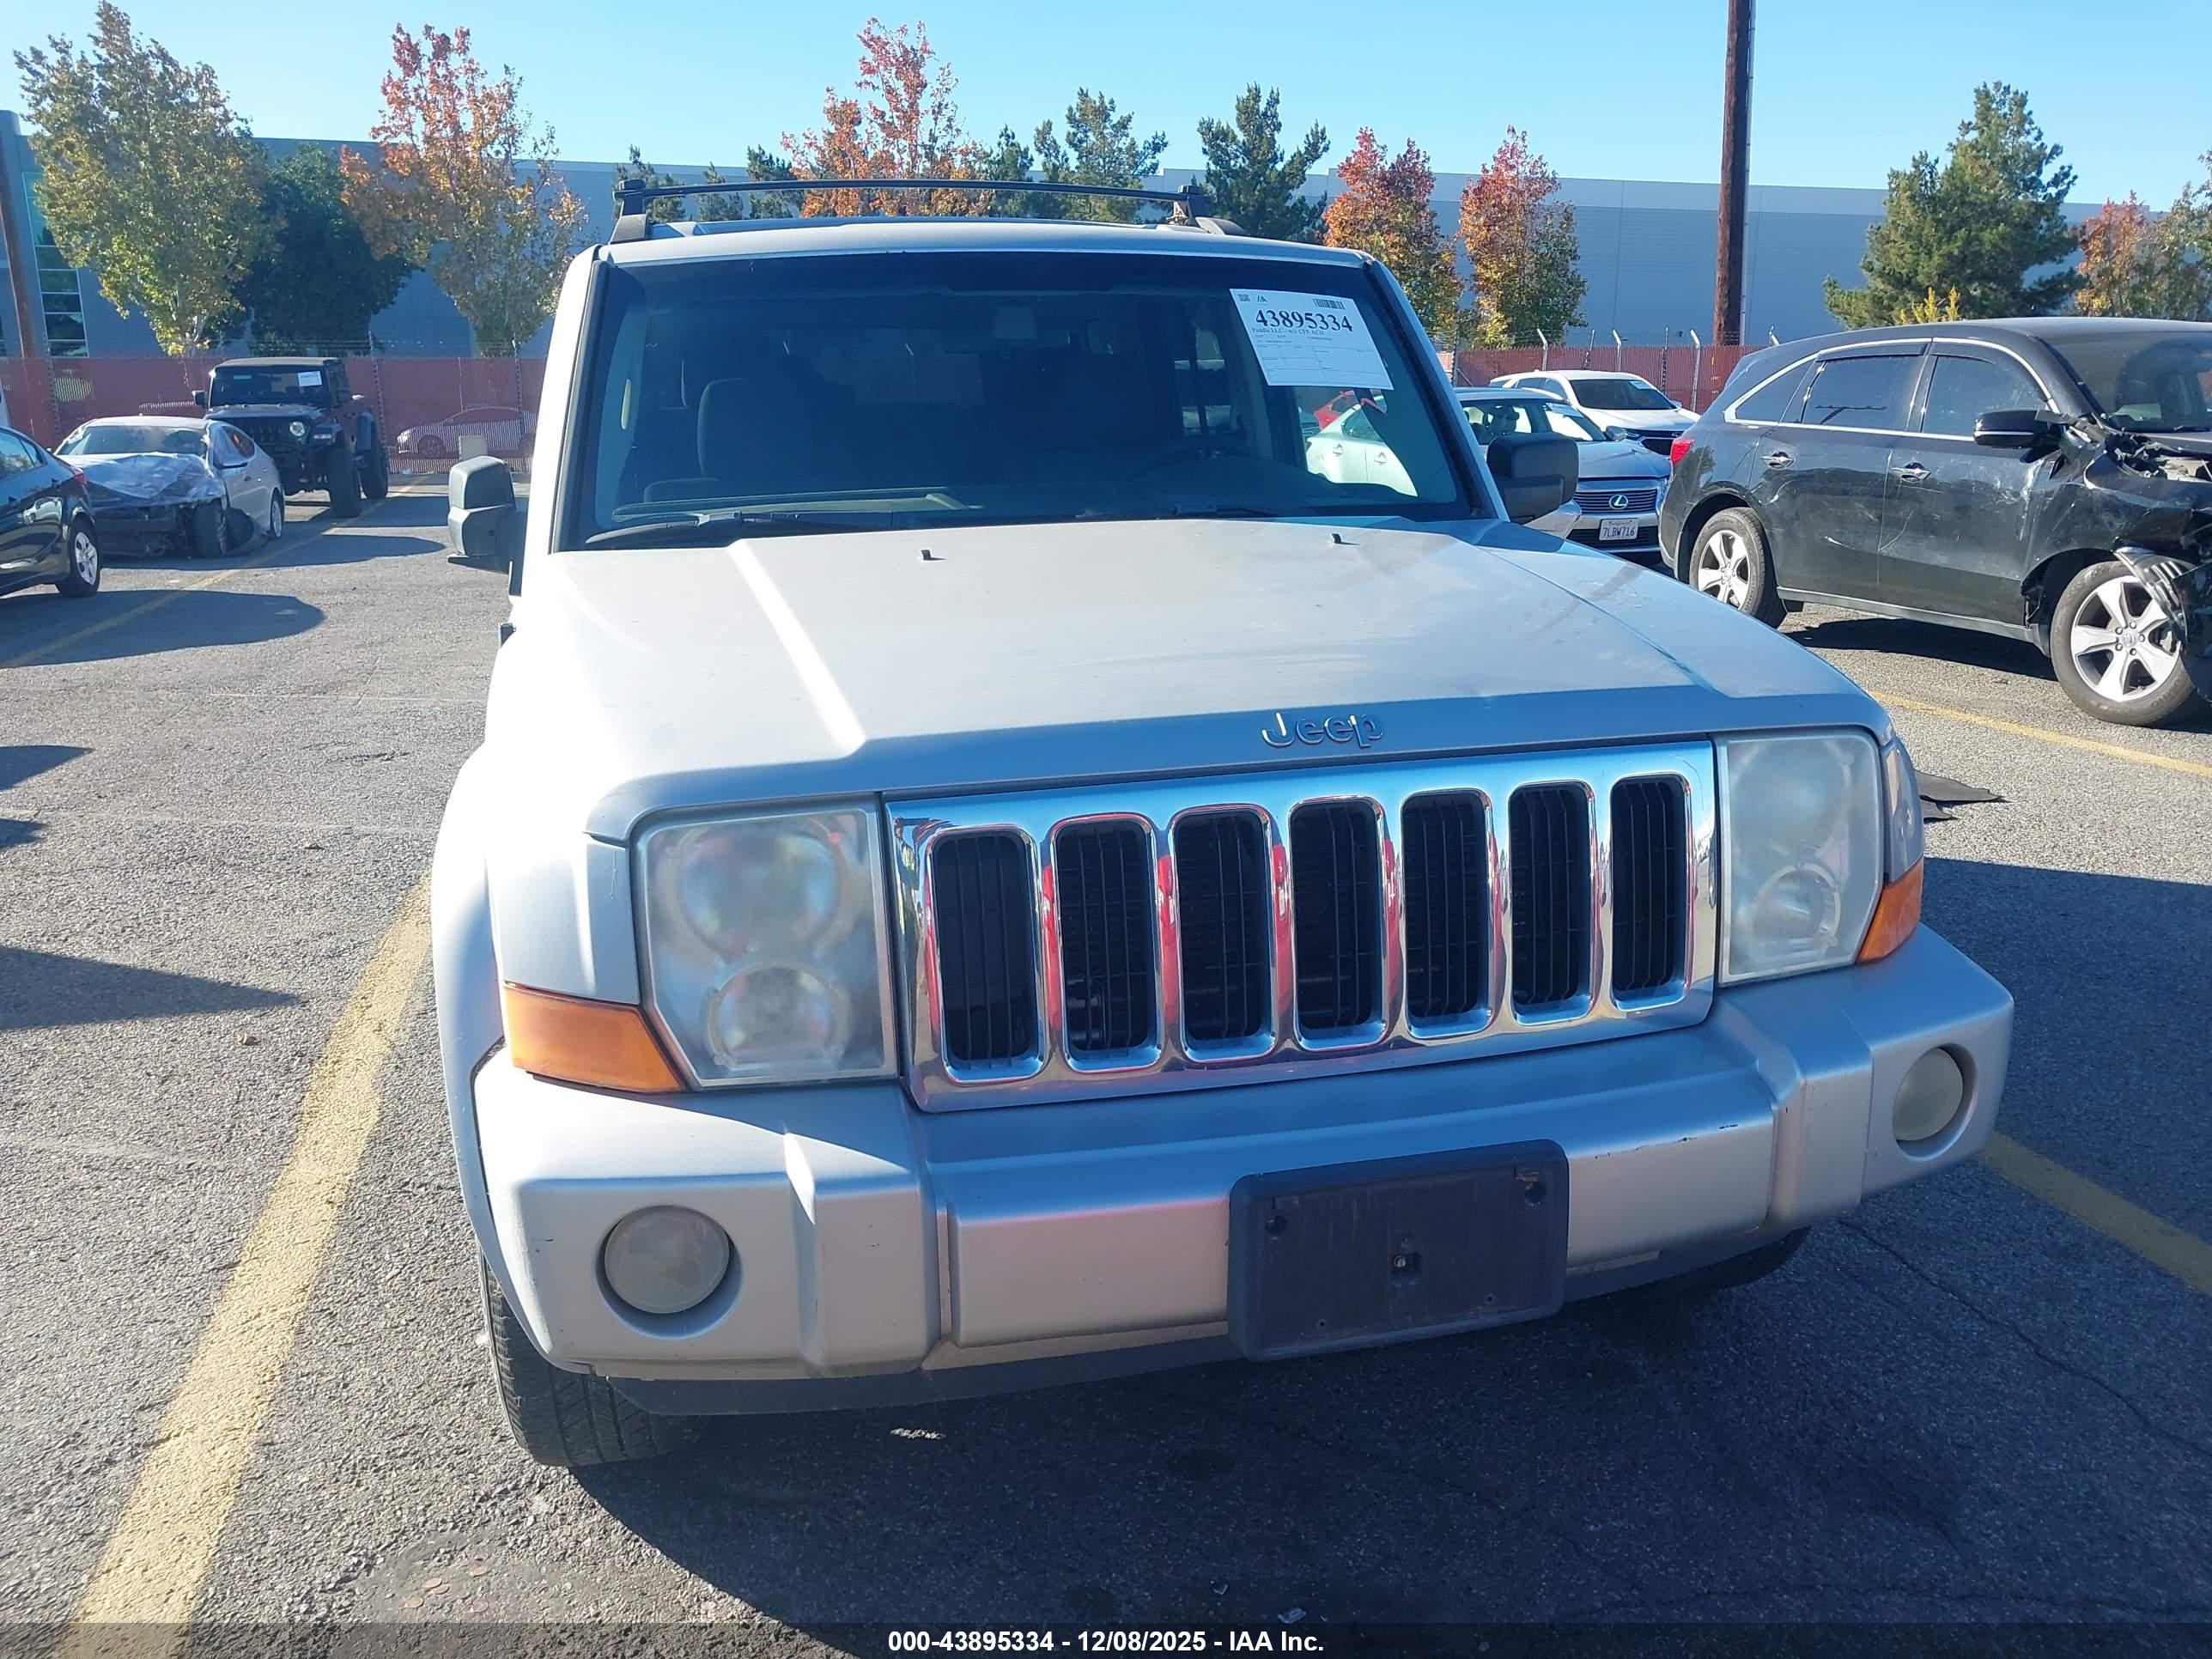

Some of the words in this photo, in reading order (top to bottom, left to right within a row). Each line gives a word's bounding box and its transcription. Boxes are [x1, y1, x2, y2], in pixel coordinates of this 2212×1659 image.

[1255, 309, 1353, 331] 43895334
[1603, 526, 1636, 538] 7LBW716
[1261, 712, 1383, 749] Jeep
